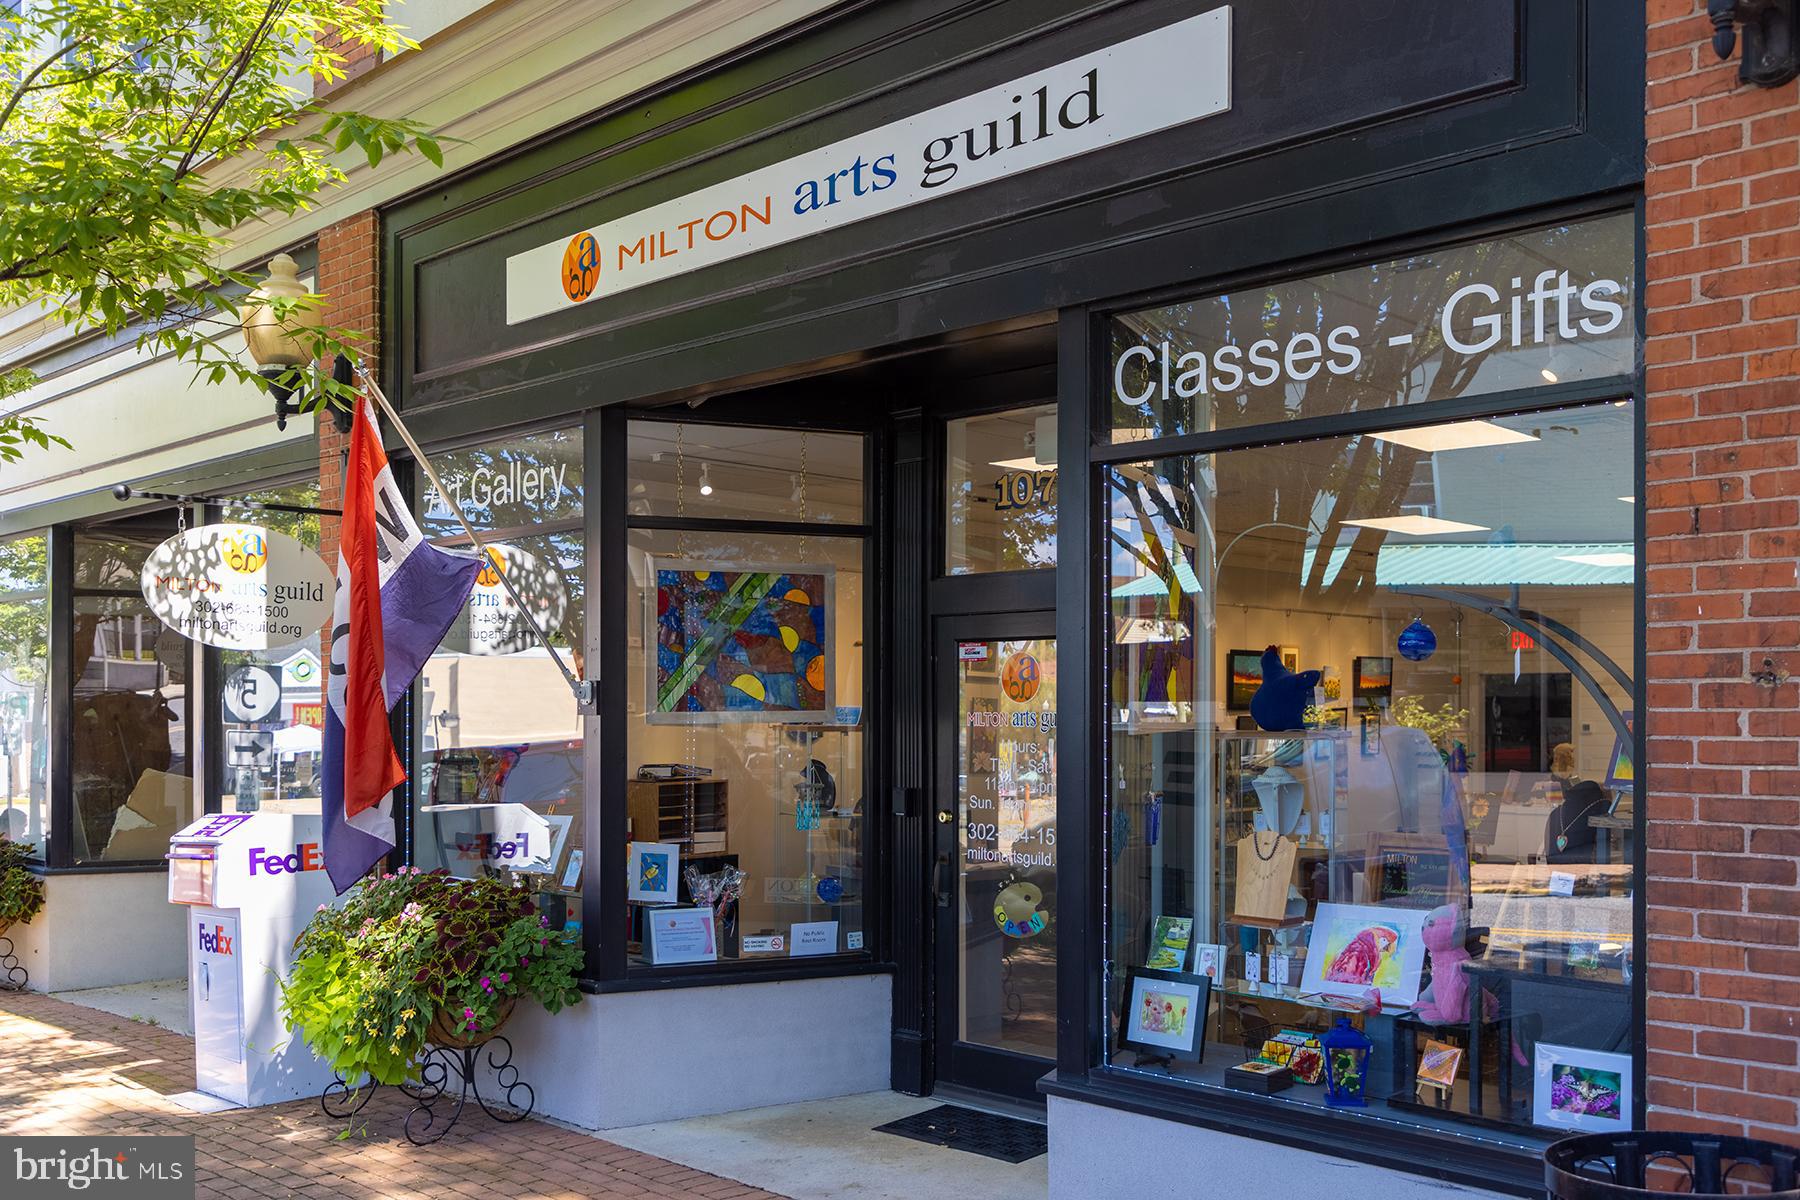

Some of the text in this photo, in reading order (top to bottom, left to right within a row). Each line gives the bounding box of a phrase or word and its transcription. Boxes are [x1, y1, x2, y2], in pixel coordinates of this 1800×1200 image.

[618, 68, 1105, 271] MILTON arts guild
[1114, 324, 1362, 406] Classes
[1441, 269, 1624, 355] Gifts
[472, 461, 566, 508] Gallery
[995, 470, 1057, 510] 107
[156, 576, 223, 592] MILTON
[274, 582, 323, 603] guild
[195, 600, 288, 618] 302-6-1500
[966, 711, 1009, 727] MILTON
[1012, 710, 1037, 728] arts
[1028, 759, 1052, 773] Sat.
[969, 795, 996, 810] Sun.
[1386, 854, 1418, 865] MILTON
[199, 923, 233, 956] FedEx
